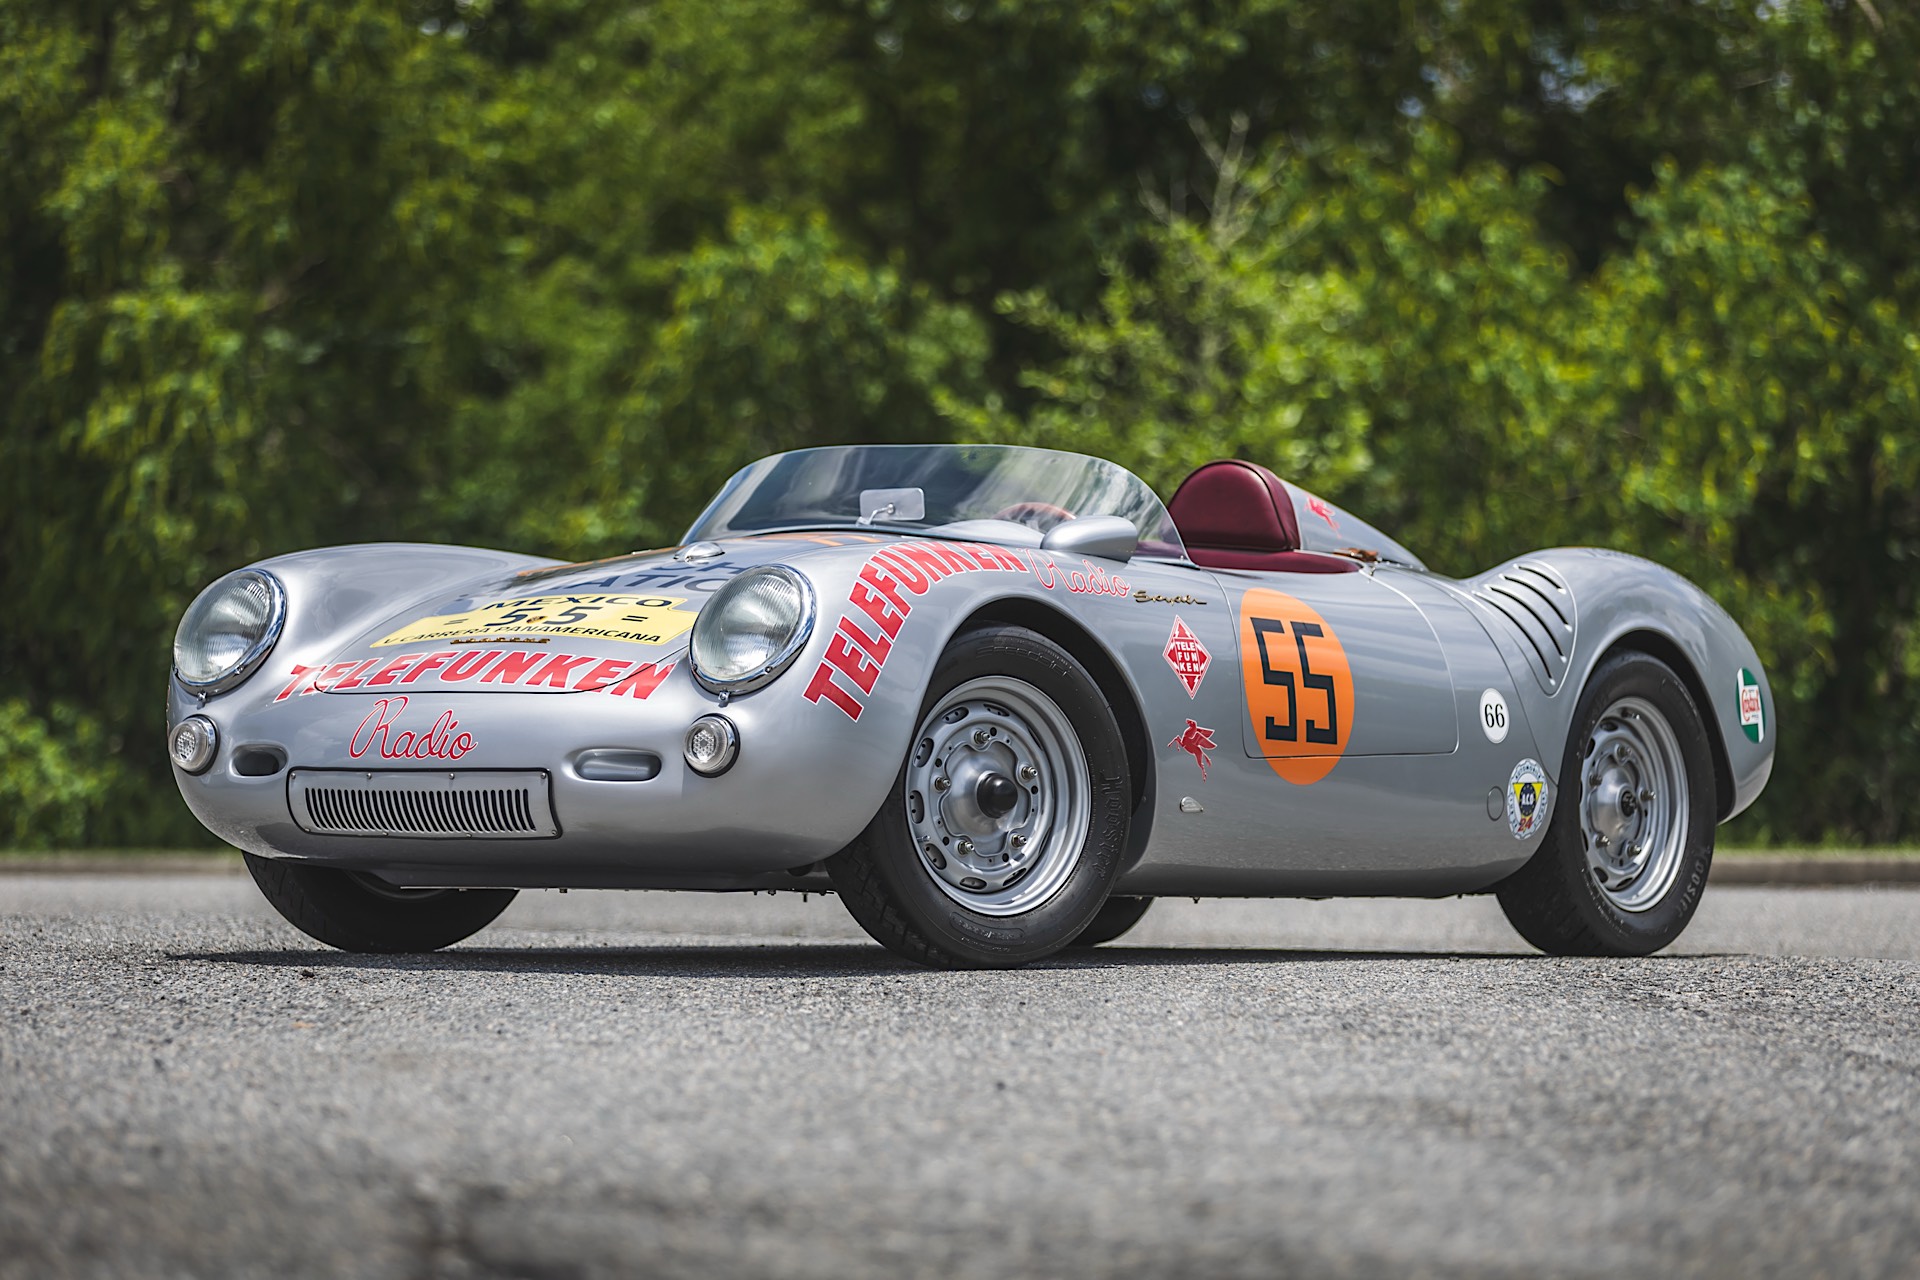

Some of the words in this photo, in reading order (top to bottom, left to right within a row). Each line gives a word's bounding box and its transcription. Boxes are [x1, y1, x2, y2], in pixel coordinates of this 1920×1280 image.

[1017, 548, 1132, 598] Radio
[481, 596, 673, 611] MEXICO
[400, 627, 491, 642] CARRERA
[494, 626, 662, 642] PANAMERICANA
[802, 540, 1031, 723] TELEFUNKEN
[1175, 641, 1196, 651] TELE
[1178, 651, 1198, 662] FUN
[273, 650, 679, 701] TELEFUNKEN
[1179, 662, 1200, 672] KEN
[1250, 617, 1338, 745] 55
[1484, 703, 1505, 729] 66
[348, 696, 479, 761] Radio
[1517, 815, 1534, 833] 24
